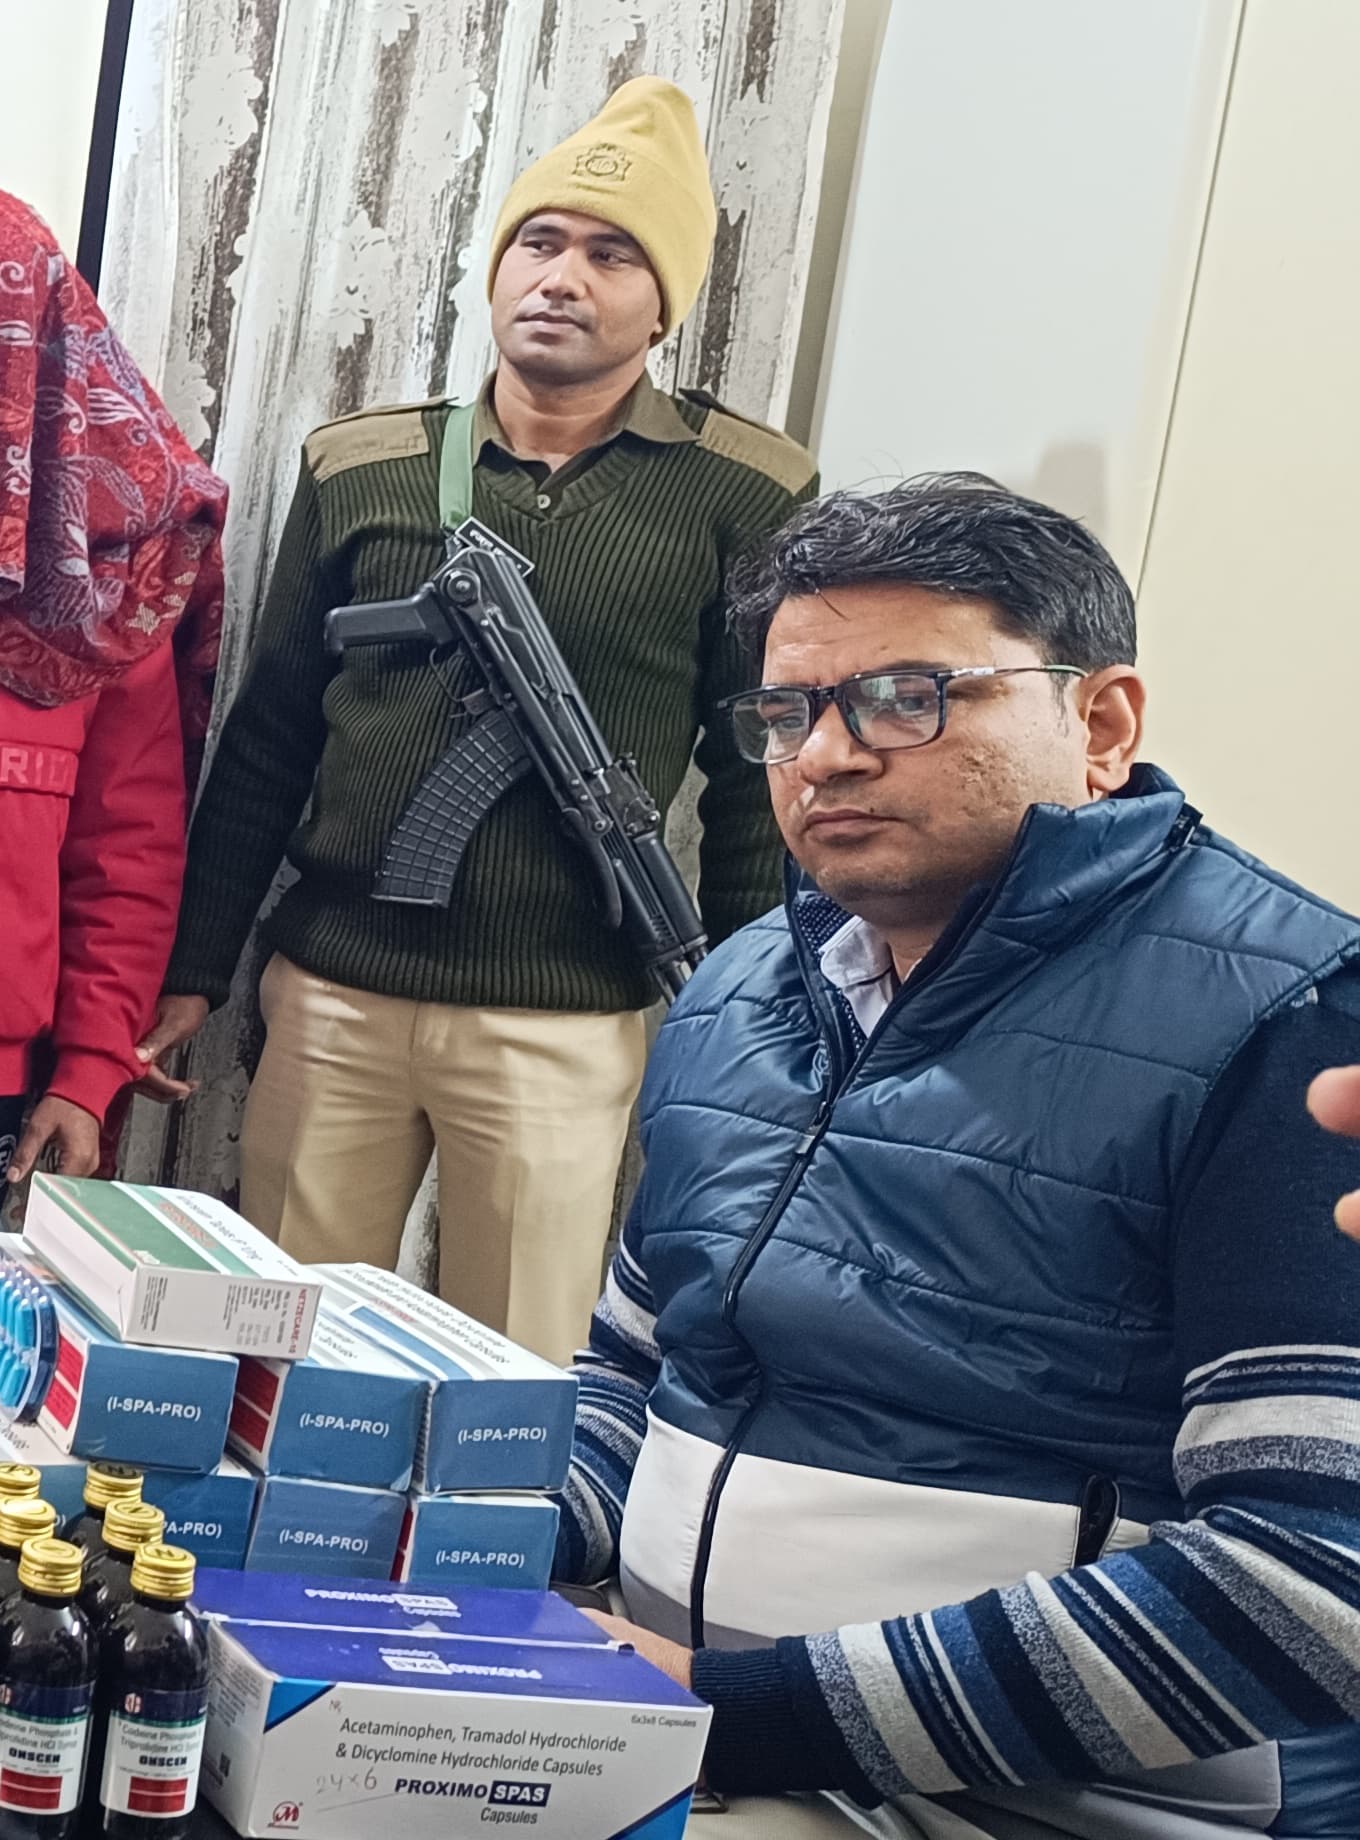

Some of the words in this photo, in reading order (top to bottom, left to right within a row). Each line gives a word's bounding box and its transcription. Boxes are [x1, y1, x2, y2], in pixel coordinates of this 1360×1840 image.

[106, 1395, 202, 1422] (I-SPA-PRO)
[299, 1412, 390, 1437] (I-SPA-PRO)
[457, 1426, 548, 1444] (I-SPA-PRO)
[279, 1528, 369, 1554] (I-SPA-PRO)
[435, 1549, 526, 1568] (I-SPA-PRO)
[658, 1716, 697, 1728] Capsules
[339, 1717, 457, 1743] Acetaminophen,
[461, 1726, 526, 1745] Tramadol
[530, 1731, 627, 1752] Hydrochloride
[335, 1743, 347, 1758] &
[351, 1744, 438, 1765] Dicyclomine
[440, 1750, 540, 1772] Hydrochloride
[542, 1757, 604, 1777] Capsules
[394, 1778, 488, 1798] PROXIMO
[493, 1784, 546, 1802] SPAS
[480, 1806, 538, 1825] Capsules
